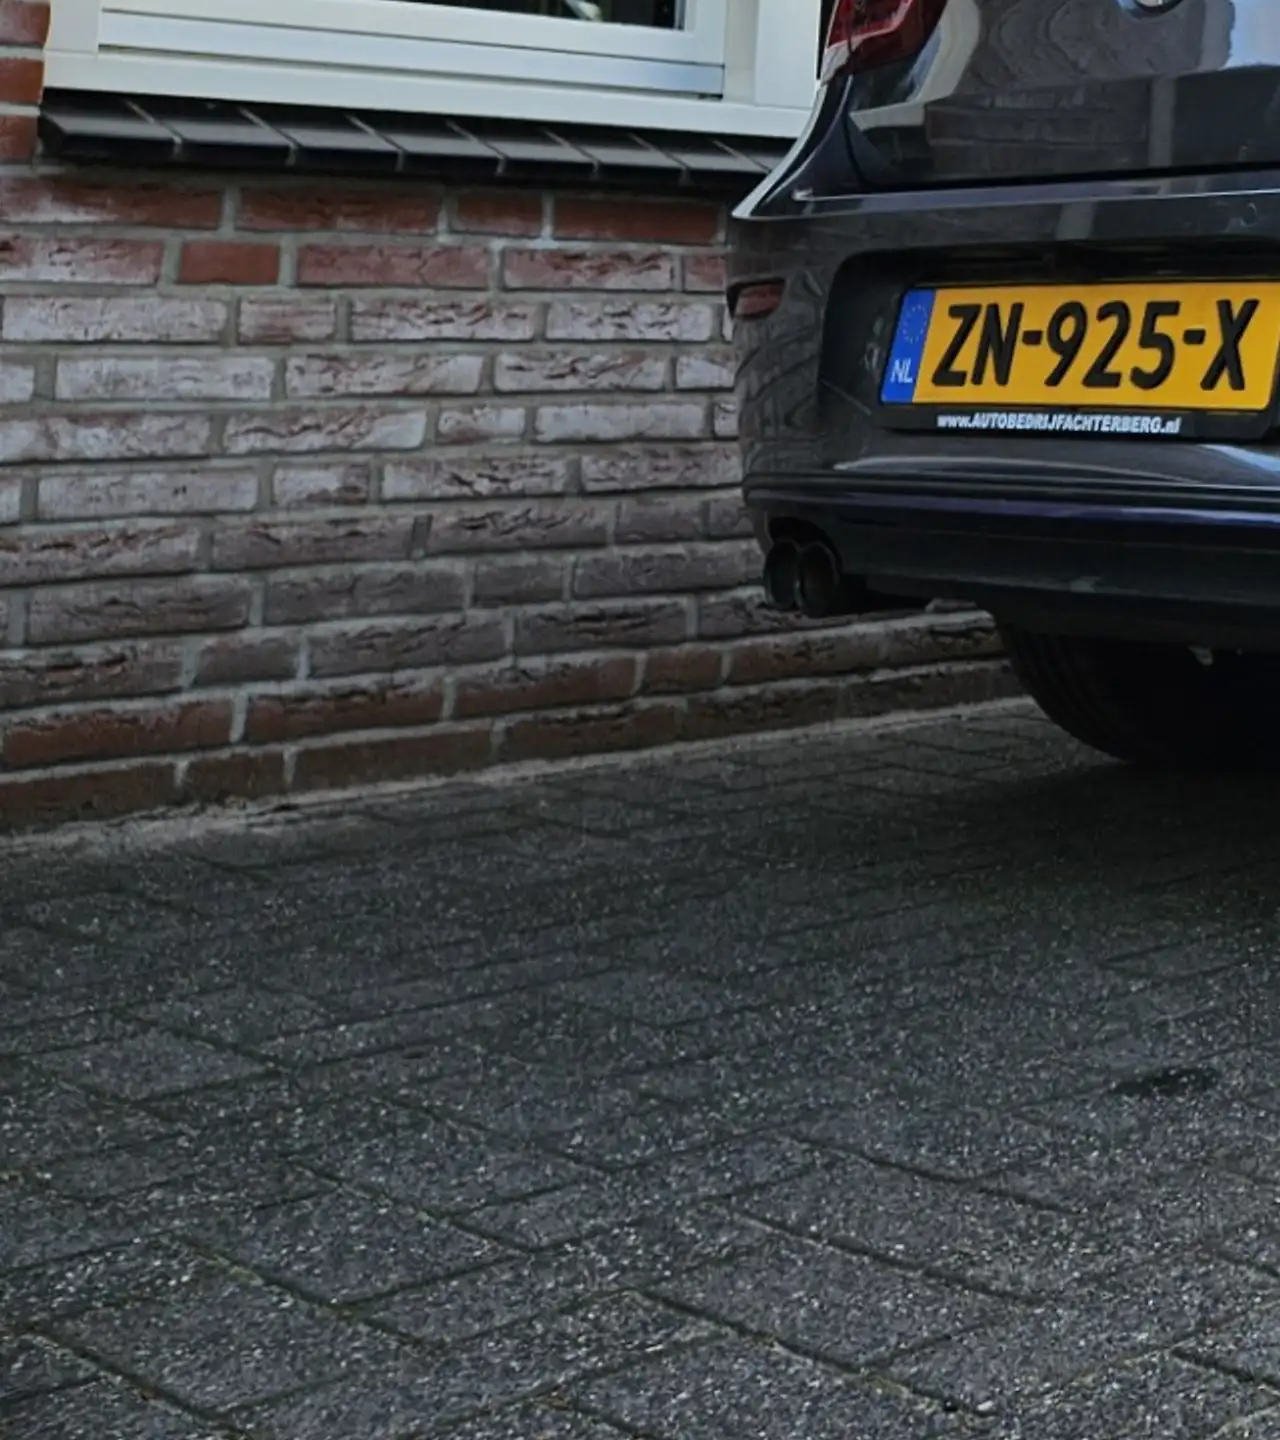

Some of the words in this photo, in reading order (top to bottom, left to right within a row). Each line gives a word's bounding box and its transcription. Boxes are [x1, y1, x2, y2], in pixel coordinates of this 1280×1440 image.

[931, 300, 1260, 391] ZN-925-X
[890, 358, 914, 385] NL
[937, 412, 1182, 434] www.AUTOBEDRIJFACHTERBERG.nl
